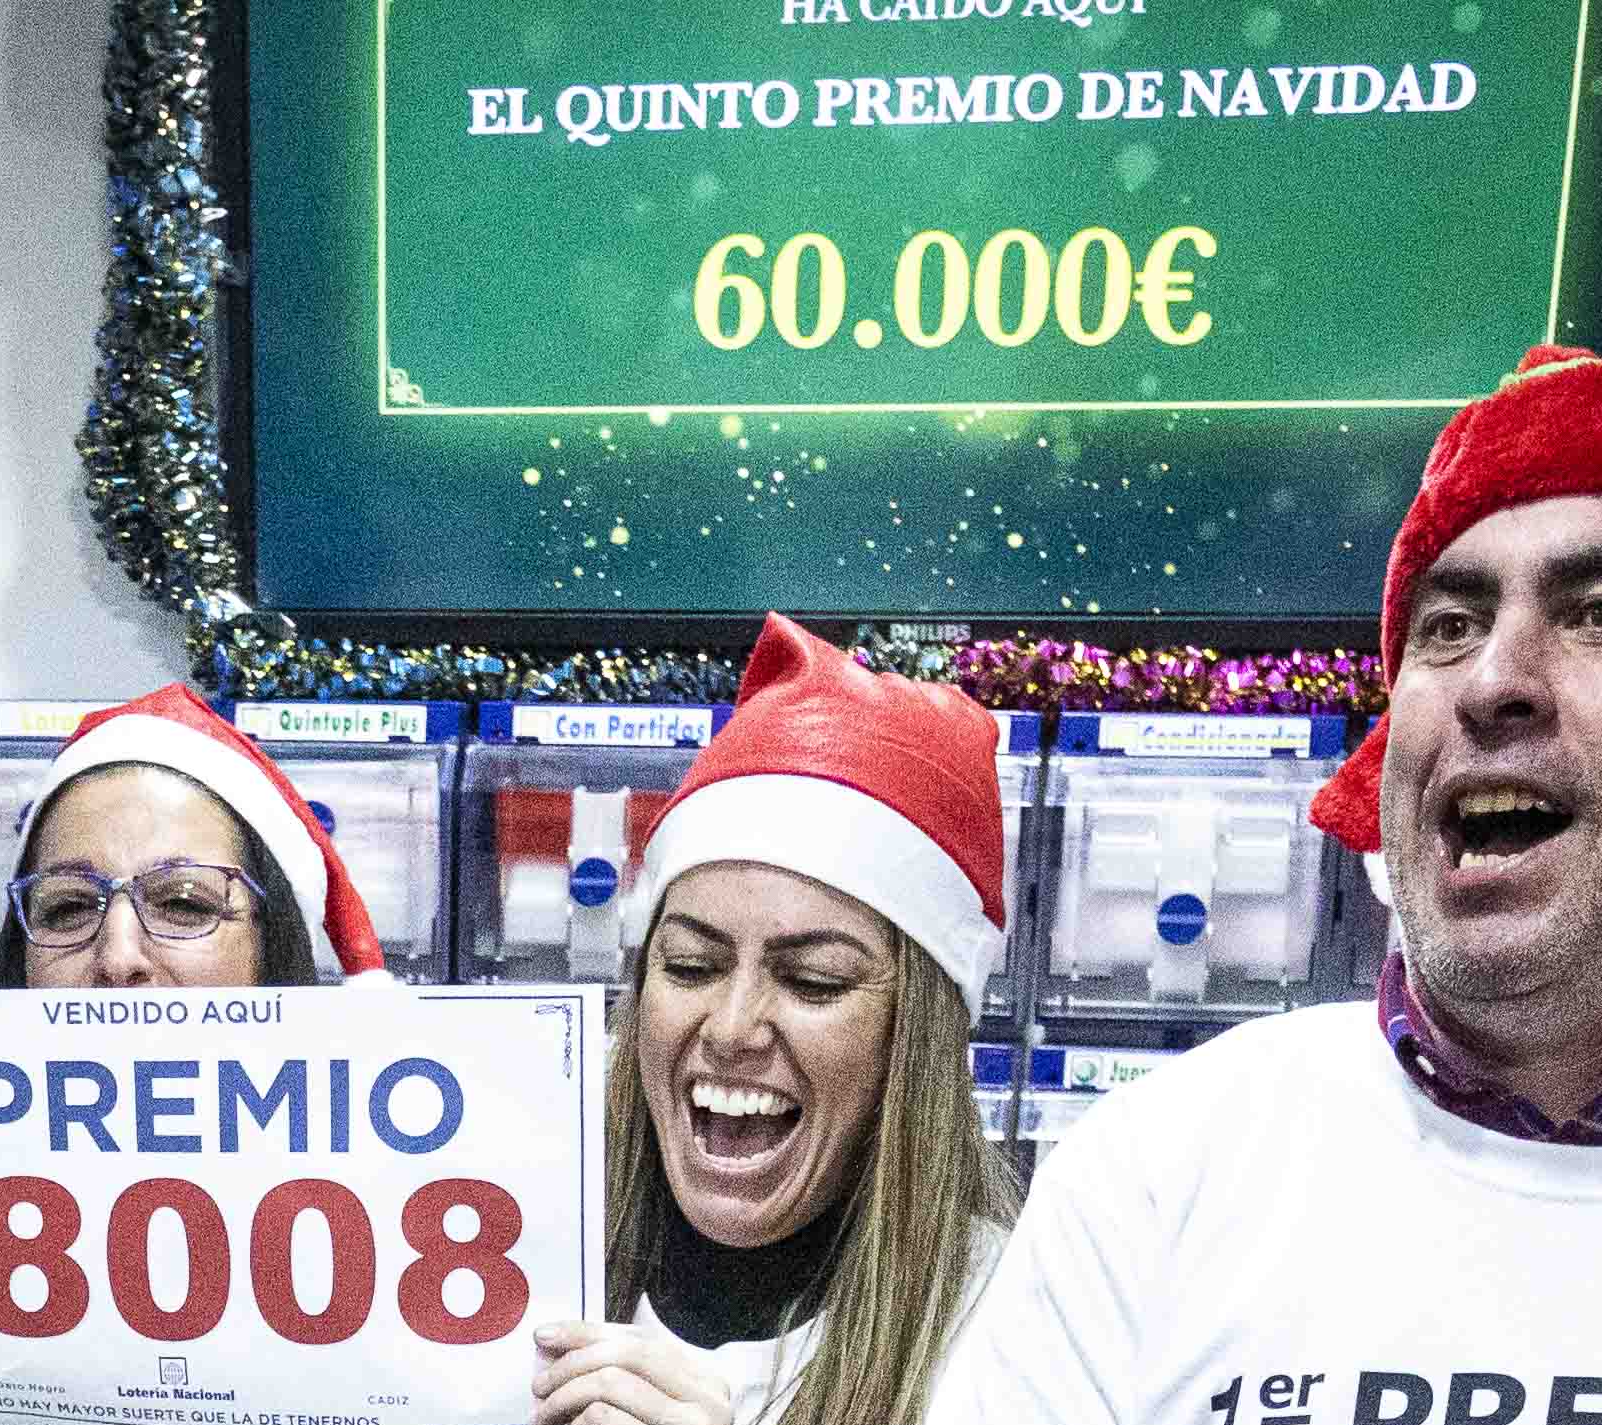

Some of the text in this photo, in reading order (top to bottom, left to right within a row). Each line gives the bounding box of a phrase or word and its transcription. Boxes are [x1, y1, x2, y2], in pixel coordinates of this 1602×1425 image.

[781, 0, 850, 24] HA
[467, 61, 1477, 146] EL QUINTO PREMIO DE NAVIDAD
[694, 225, 1220, 352] 60.000€
[279, 711, 420, 736] Quintuple Plus
[556, 714, 597, 738] Con
[42, 994, 284, 1028] VENDIDO AQUÍ
[117, 1385, 236, 1402] Lotería Nacional
[368, 1395, 410, 1406] CADIZ
[19, 1398, 54, 1413] HAY
[57, 1403, 118, 1419] MAYOR
[121, 1407, 185, 1423] SUERTE
[190, 1410, 227, 1425] QUE
[231, 1411, 256, 1425] LA
[259, 1412, 283, 1425] DE
